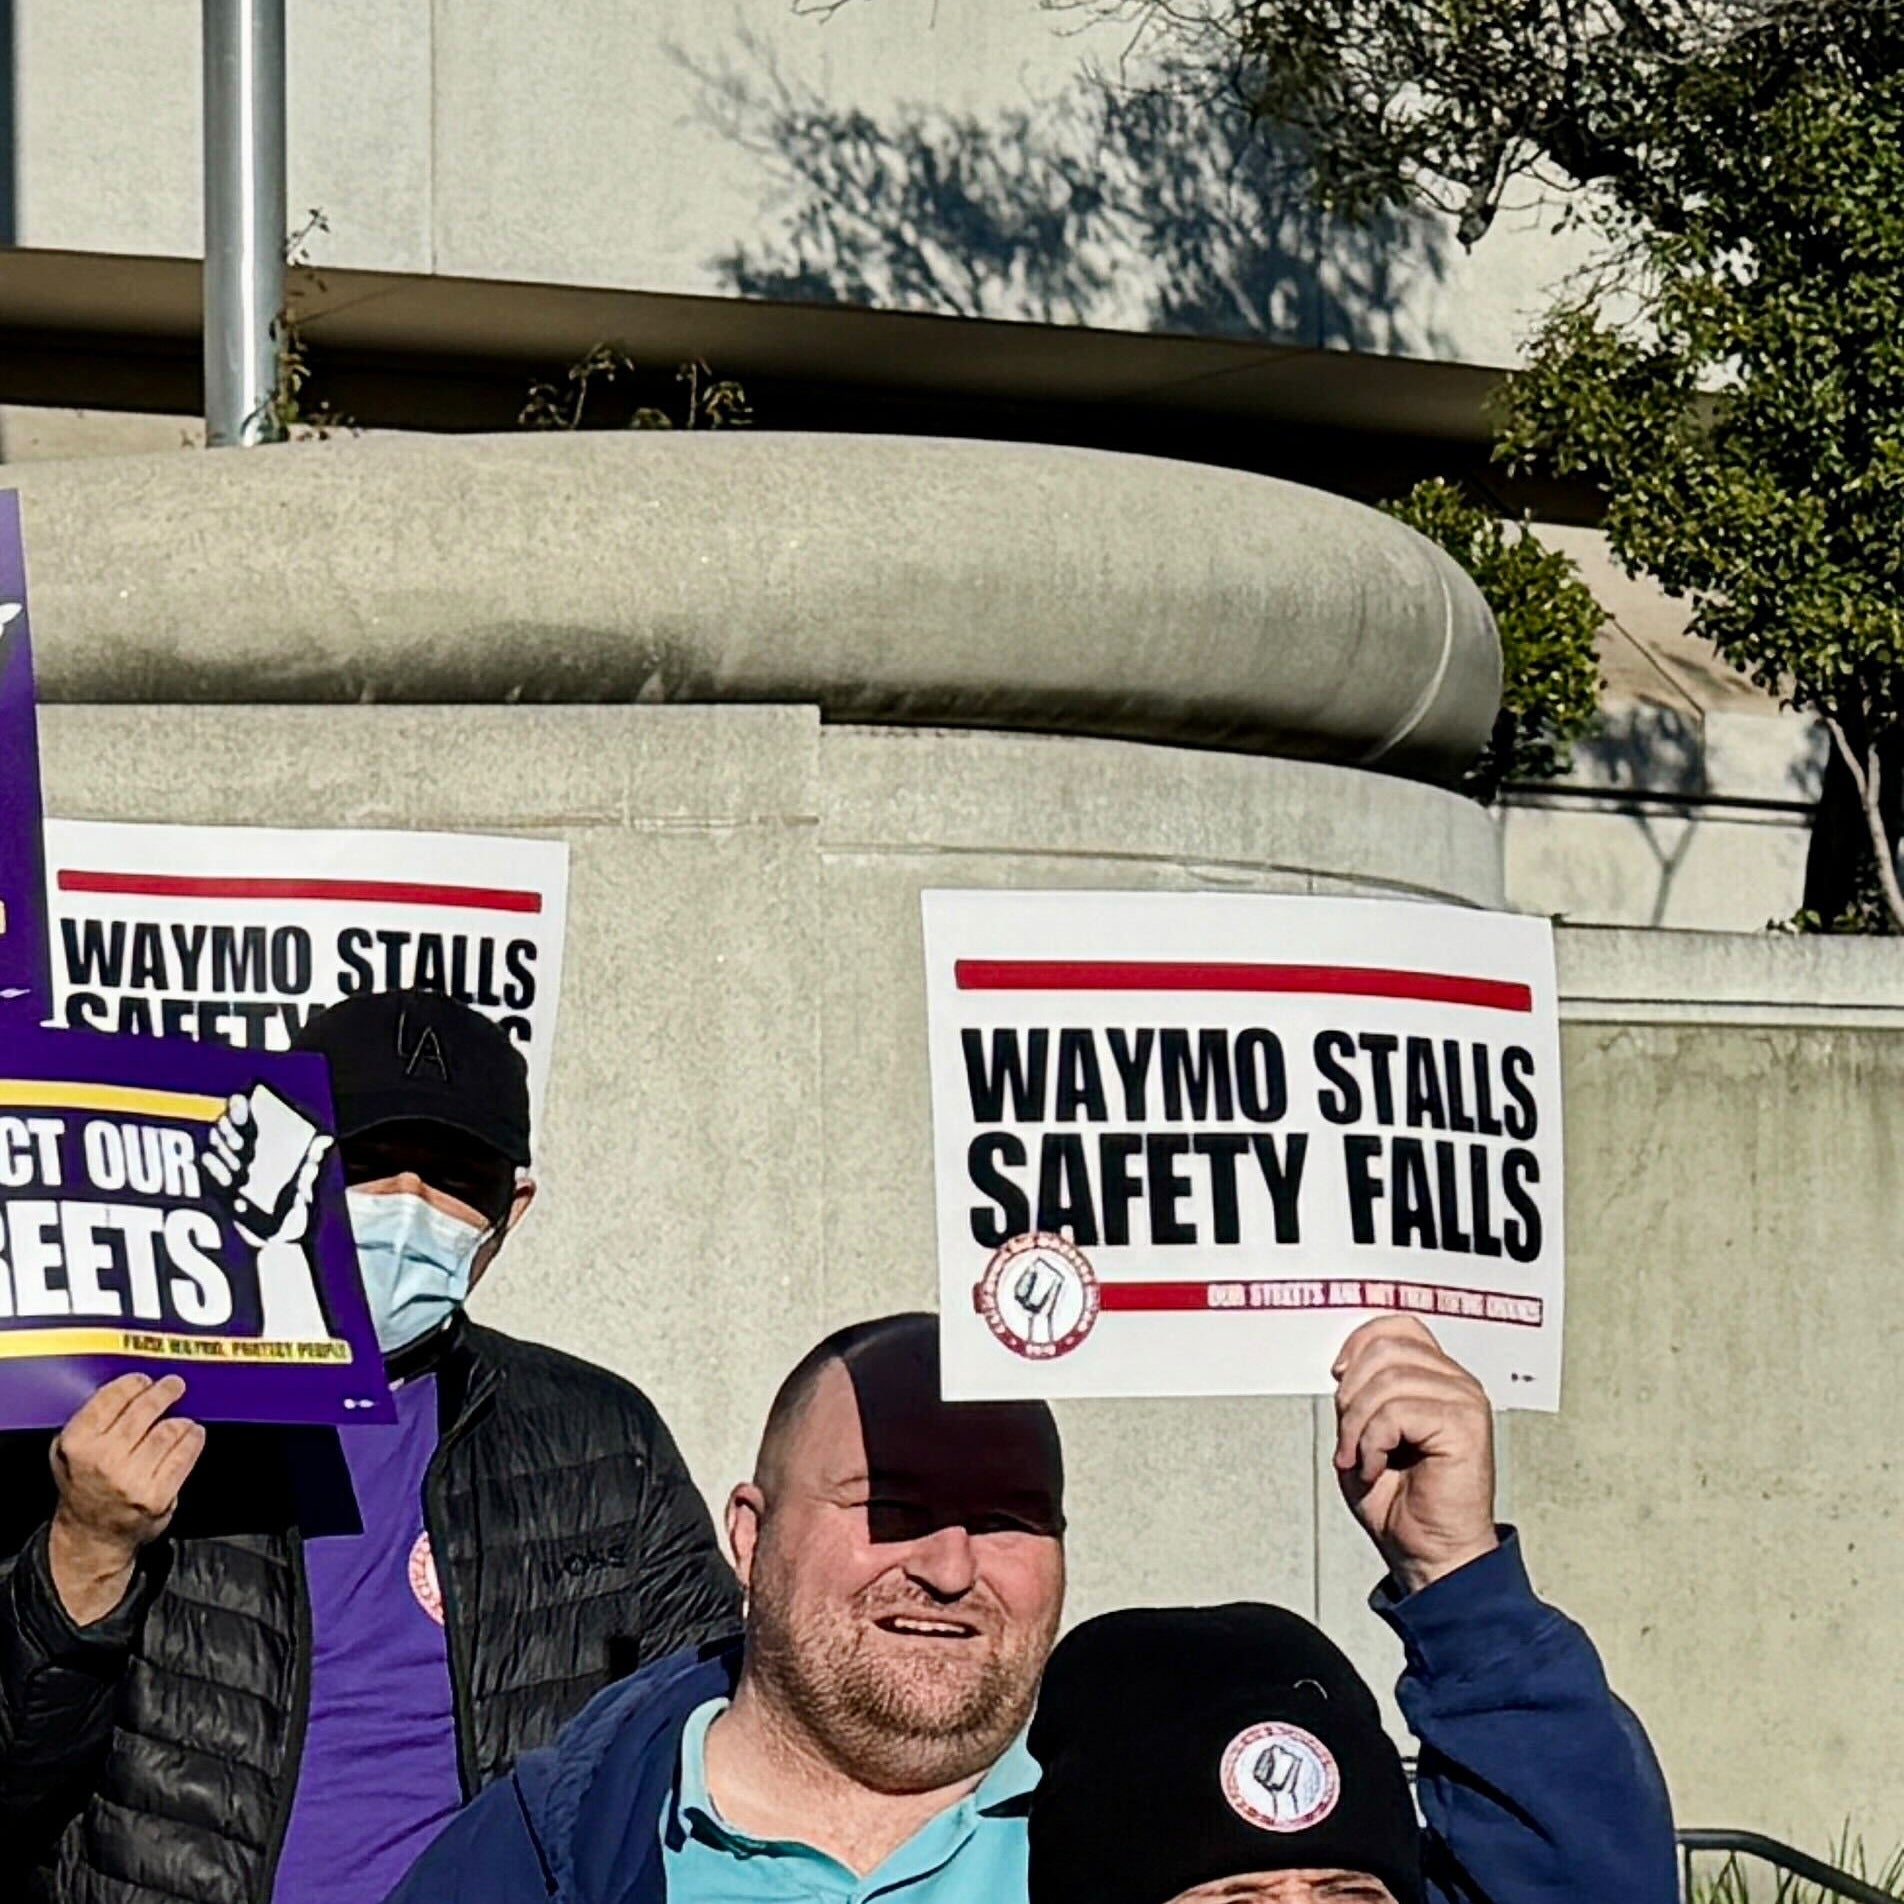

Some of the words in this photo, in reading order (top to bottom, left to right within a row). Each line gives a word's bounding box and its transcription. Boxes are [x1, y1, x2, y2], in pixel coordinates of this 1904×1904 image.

[59, 916, 311, 999] WAYMO
[336, 925, 538, 1012] STALLS
[397, 1009, 449, 1082] LA
[960, 1027, 1288, 1124] WAYMO
[1312, 1029, 1537, 1142] STALLS
[84, 1118, 202, 1199] OUR
[967, 1131, 1308, 1250] SAFETY
[1343, 1134, 1543, 1264] FALLS
